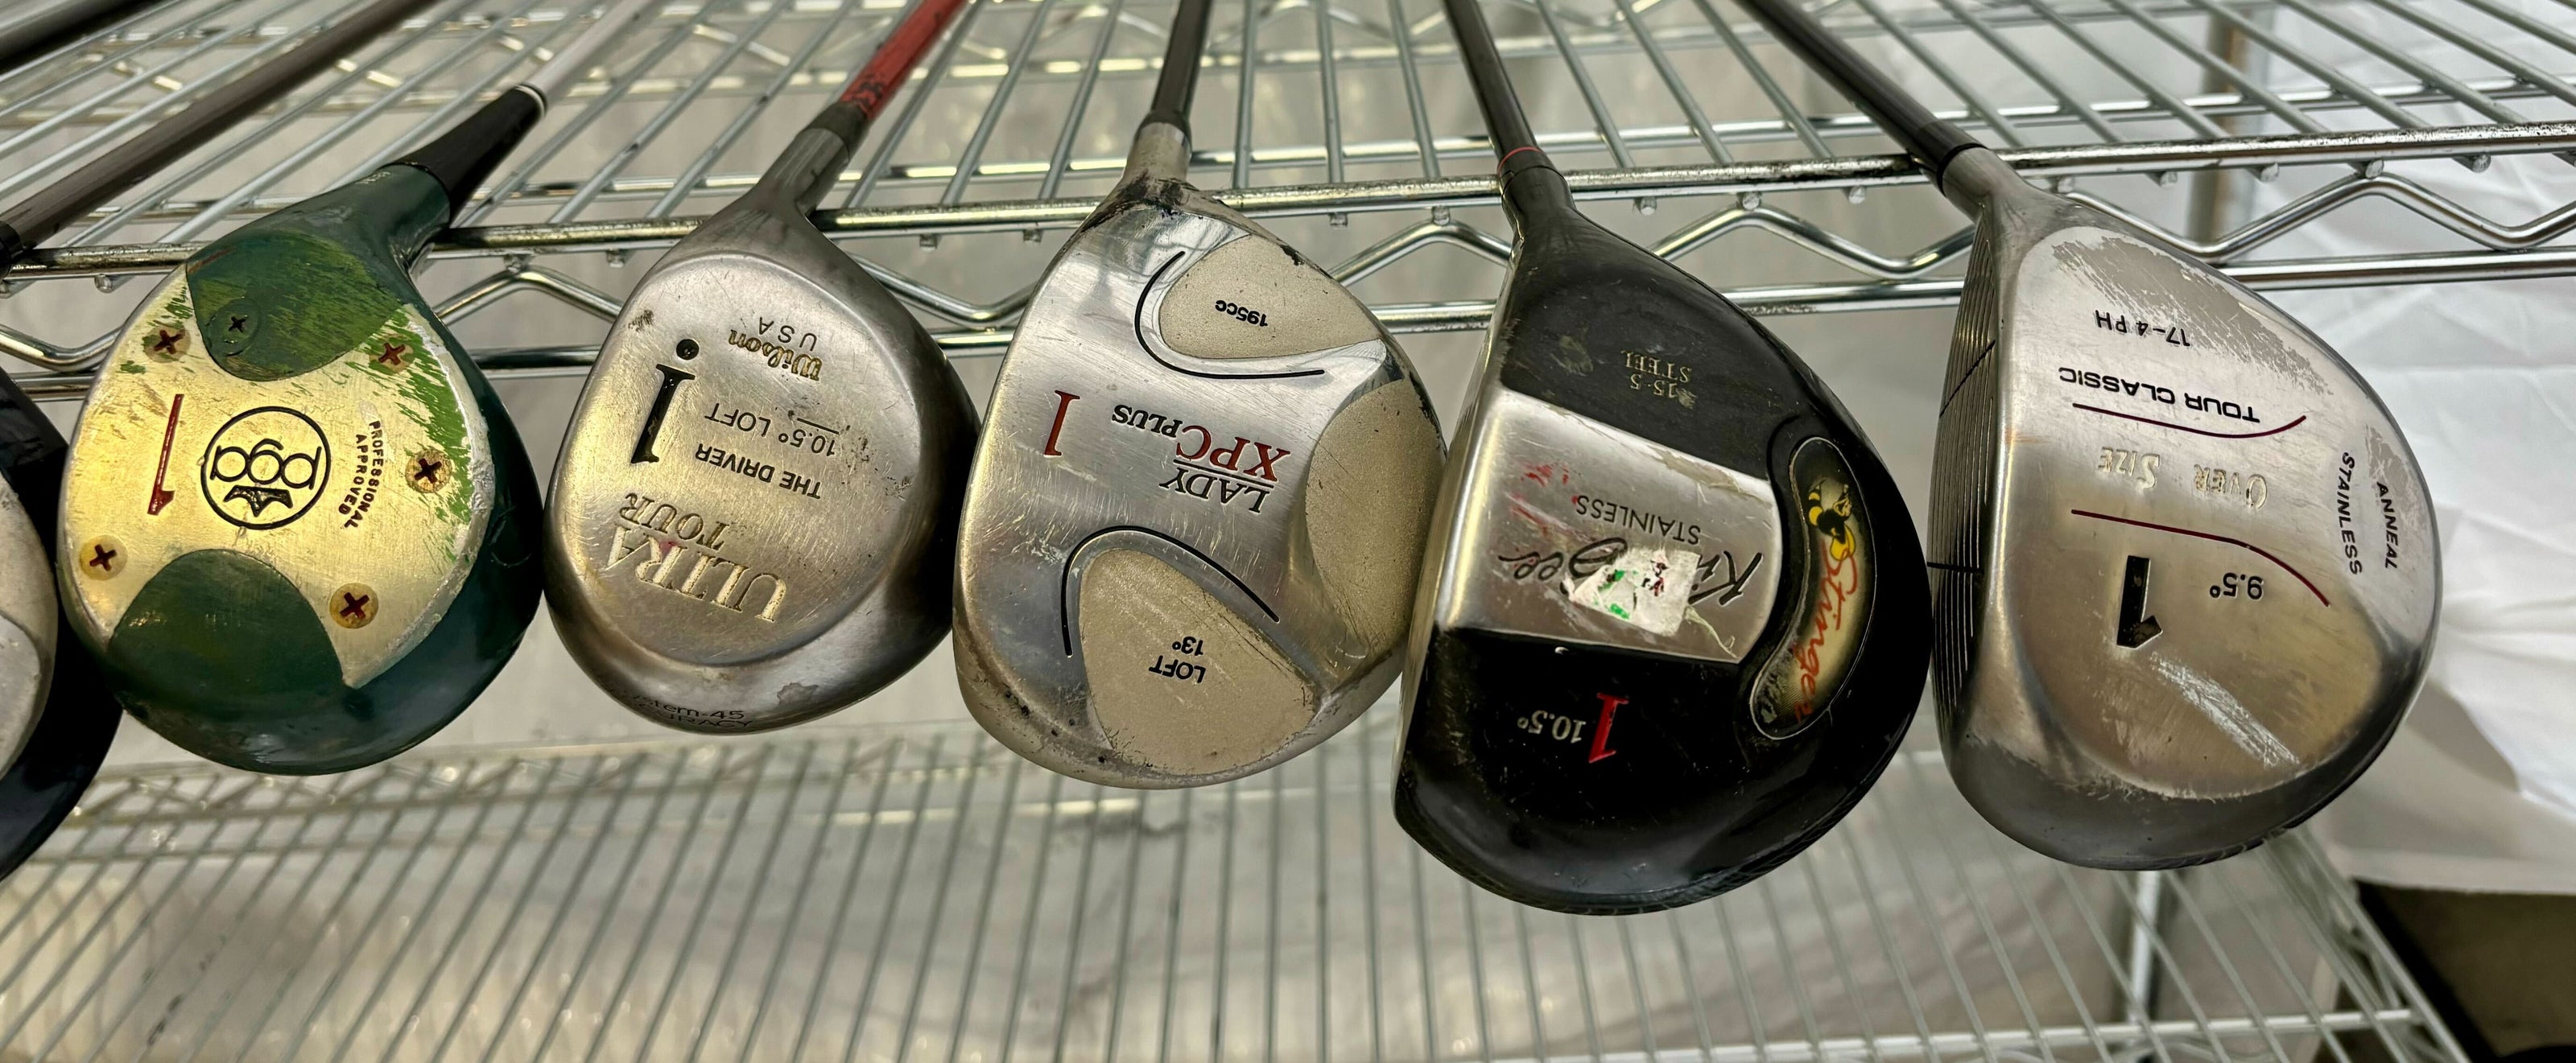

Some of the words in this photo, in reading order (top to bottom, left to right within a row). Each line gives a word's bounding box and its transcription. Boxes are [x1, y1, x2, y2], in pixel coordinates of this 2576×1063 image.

[1215, 299, 1268, 327] 195cc
[2095, 310, 2128, 334] PH
[728, 329, 822, 381] Wilson
[1621, 350, 1693, 383] STEEL
[2058, 367, 2175, 404] CLASSIC
[2185, 393, 2260, 422] TOUR
[704, 402, 772, 438] LOFT
[778, 428, 836, 457] 10.5°
[1043, 389, 1080, 456] 1
[1112, 404, 1183, 438] PLUS
[147, 393, 184, 516] 1
[338, 434, 369, 514] APPROVED
[344, 420, 385, 529] PROFESSIONAL
[696, 443, 775, 484] DRIVER
[1176, 425, 1291, 482] XPC
[779, 471, 821, 499] THE
[1159, 467, 1270, 513] LADY
[619, 492, 730, 551] TOUR
[1575, 495, 1701, 546] STAINLESS
[2337, 451, 2363, 575] STAINLESS
[2376, 481, 2398, 570] ANNEAL
[604, 523, 787, 623] ULTRA
[2210, 572, 2264, 600] 9.5°
[2116, 555, 2163, 649] 1
[1148, 654, 1207, 683] LOFT
[1517, 709, 1587, 744] 10.5°
[1588, 692, 1629, 764] 1
